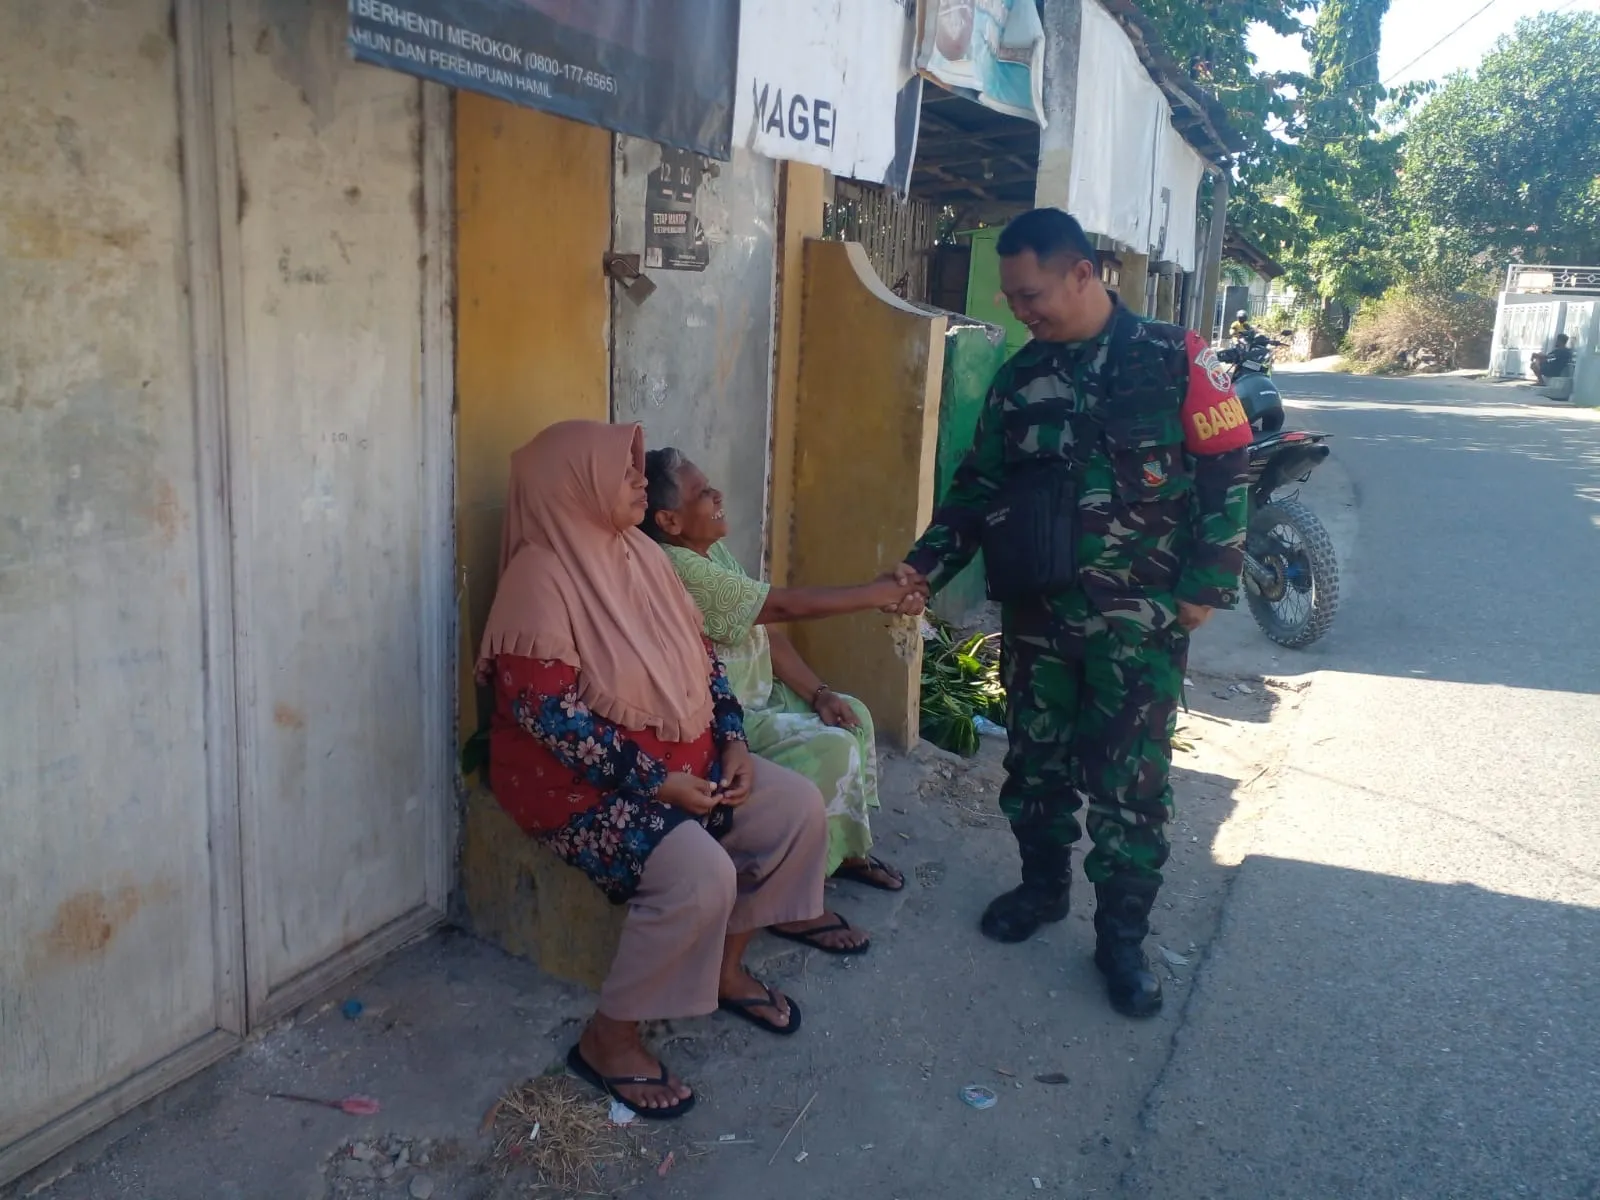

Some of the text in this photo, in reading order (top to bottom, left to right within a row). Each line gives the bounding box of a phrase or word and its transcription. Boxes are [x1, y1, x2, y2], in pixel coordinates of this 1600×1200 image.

[358, 0, 618, 95] BERHENTI MEROKOK (0800-177-6565)
[394, 38, 427, 64] DAN
[429, 49, 514, 88] PEREMPUAN
[515, 75, 553, 98] HAMIL
